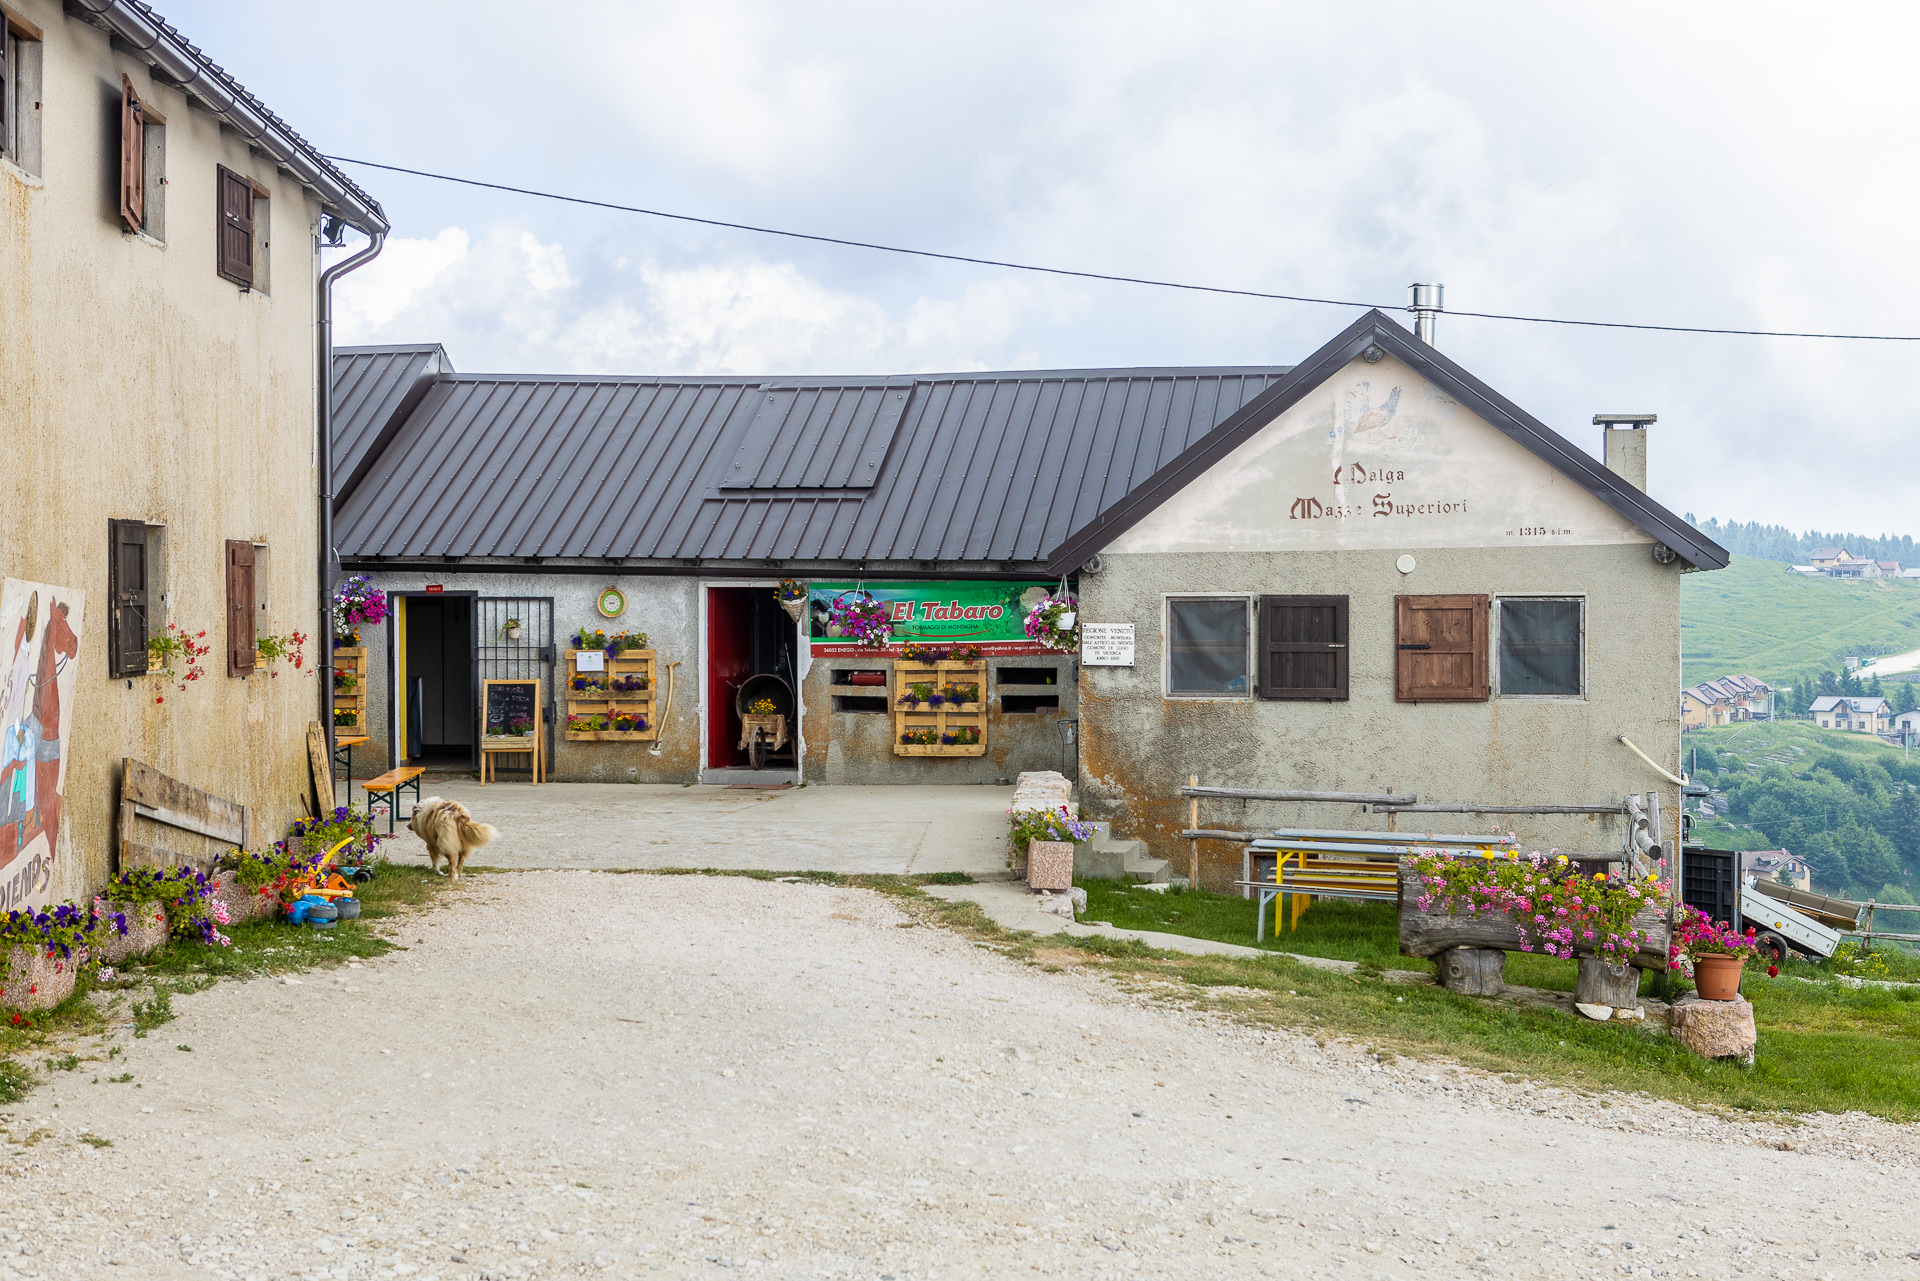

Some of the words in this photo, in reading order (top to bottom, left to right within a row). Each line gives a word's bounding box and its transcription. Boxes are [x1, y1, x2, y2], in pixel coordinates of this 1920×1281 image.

[1333, 461, 1405, 485] Malga
[1372, 493, 1467, 518] Superiori
[1519, 527, 1547, 536] 1315
[890, 600, 916, 622] El
[920, 600, 1004, 622] Tabaro
